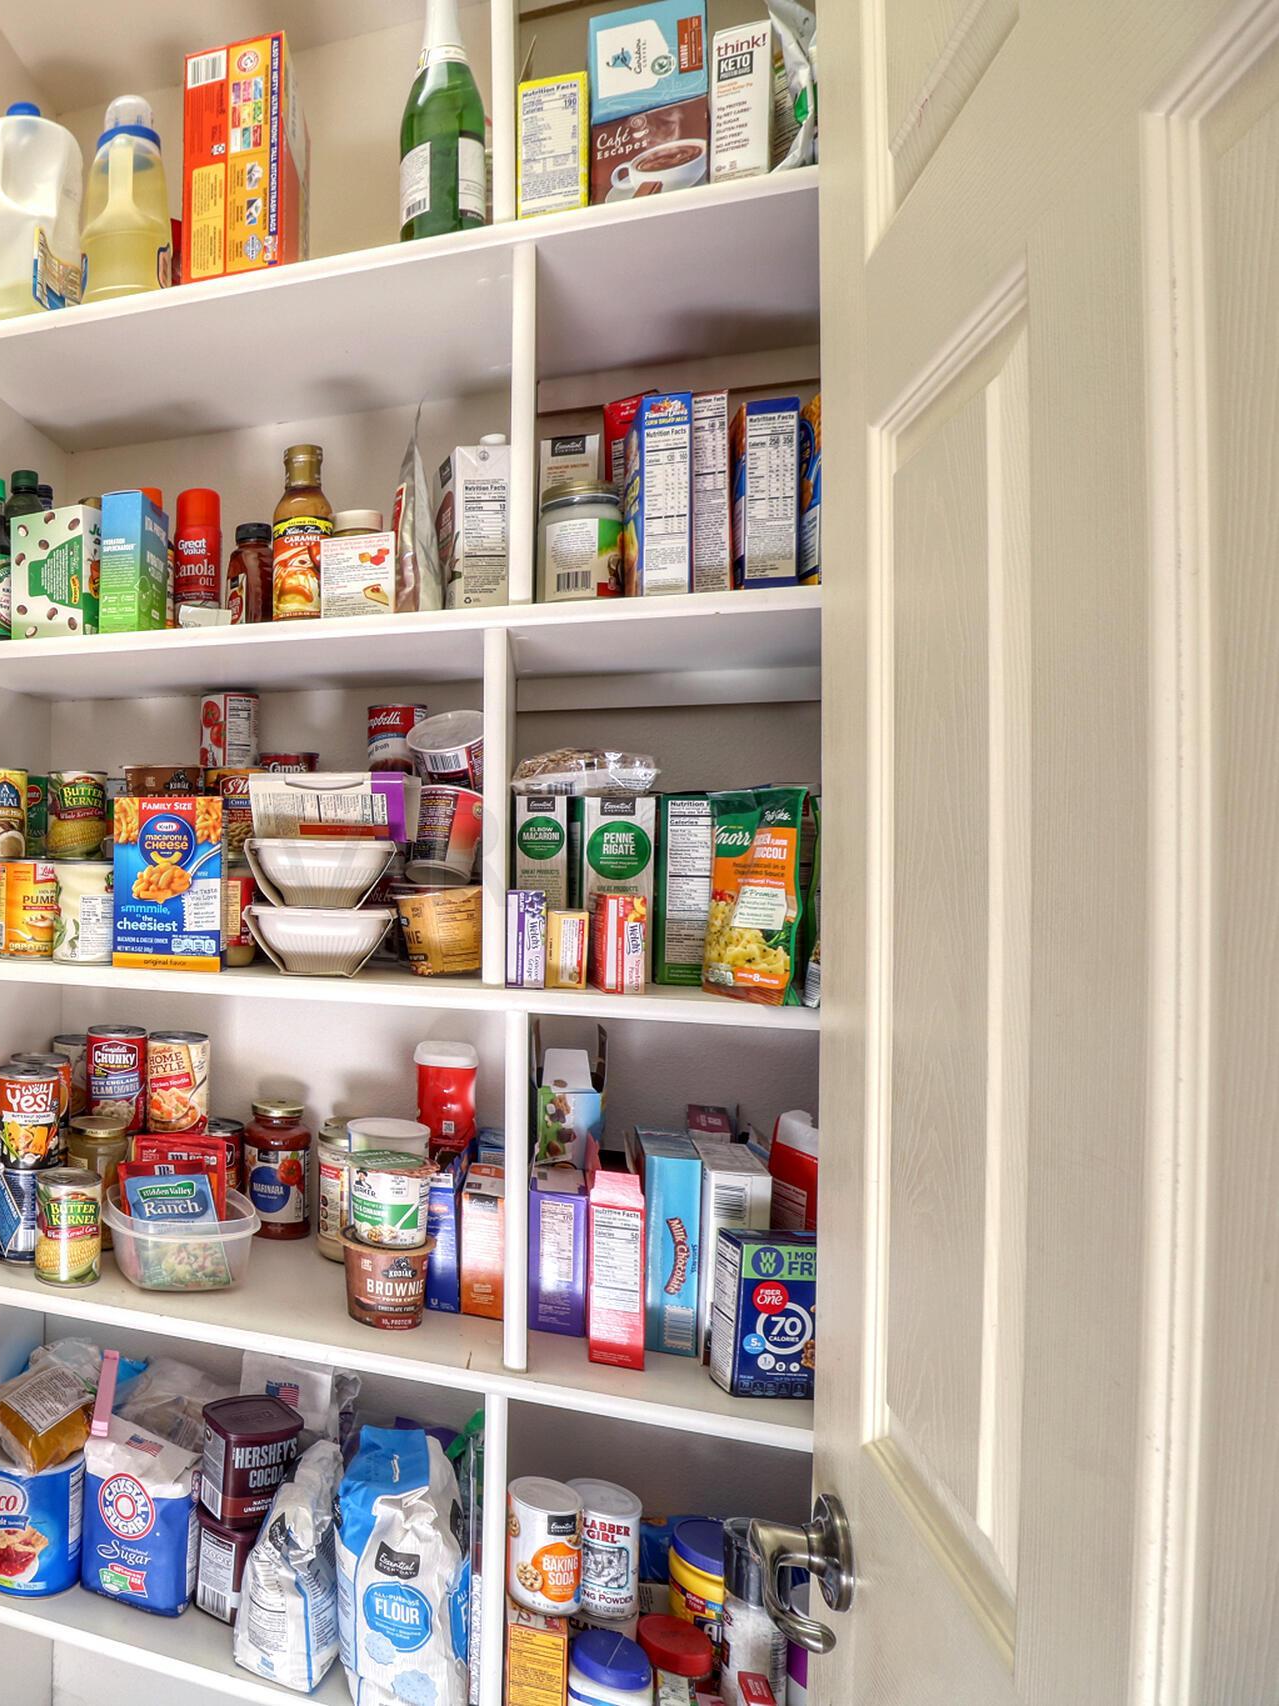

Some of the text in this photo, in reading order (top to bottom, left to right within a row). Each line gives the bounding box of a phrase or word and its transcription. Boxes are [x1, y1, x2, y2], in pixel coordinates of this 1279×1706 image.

[716, 33, 768, 58] think!
[720, 54, 751, 73] KETO
[270, 95, 279, 115] ULTRA
[596, 126, 632, 149] Café
[270, 146, 278, 162] TALL
[596, 141, 649, 161] Escapes
[270, 163, 278, 190] KITCHEN
[270, 190, 278, 212] TRASH
[270, 213, 278, 232] BAGS
[776, 413, 795, 421] Facts
[646, 427, 686, 438] Nutrition Facts
[178, 538, 207, 550] Great
[199, 577, 215, 587] OIL
[270, 761, 307, 774] Camp's
[63, 787, 103, 797] BUTTER
[142, 802, 193, 811] FAMILY SIZE
[522, 832, 560, 841] MACARONI
[603, 832, 635, 843] PENNE
[602, 843, 636, 855] RIGATE
[200, 888, 218, 896] Taste
[121, 905, 170, 915] smmmile,
[117, 920, 179, 932] cheesiest
[529, 920, 538, 950] Welch's
[629, 924, 639, 954] Welch's
[94, 1052, 136, 1065] CHUNKY
[149, 1052, 183, 1065] HOME
[150, 1062, 185, 1073] STYLE
[106, 1077, 139, 1085] ENGLAND
[7, 1084, 53, 1112] Yes!
[92, 1086, 114, 1095] CLAM
[143, 1185, 193, 1198] Hidden Valley
[253, 1183, 284, 1195] MARINARA
[50, 1203, 96, 1215] BUTTER
[144, 1200, 201, 1217] Ranch
[622, 1211, 639, 1219] Facts
[51, 1214, 96, 1225] KERNEL
[668, 1218, 687, 1242] Milk
[388, 1270, 413, 1278] KODIAK
[666, 1244, 688, 1294] Chocolate
[366, 1278, 424, 1297] BROWNIE
[771, 1317, 803, 1337] 70
[234, 1438, 298, 1469] HERSHEY'S
[249, 1468, 285, 1488] COCOA
[104, 1478, 149, 1513] CRYSTAL
[104, 1506, 147, 1535] SUGAR
[582, 1517, 631, 1537] LABBER
[587, 1529, 618, 1543] GIRL
[108, 1540, 152, 1566] Sugar
[380, 1552, 416, 1571] Essential
[542, 1555, 579, 1571] BAKING
[547, 1571, 575, 1585] SODA
[373, 1591, 420, 1606] ALL-PURPOSE
[374, 1598, 420, 1625] FLOUR
